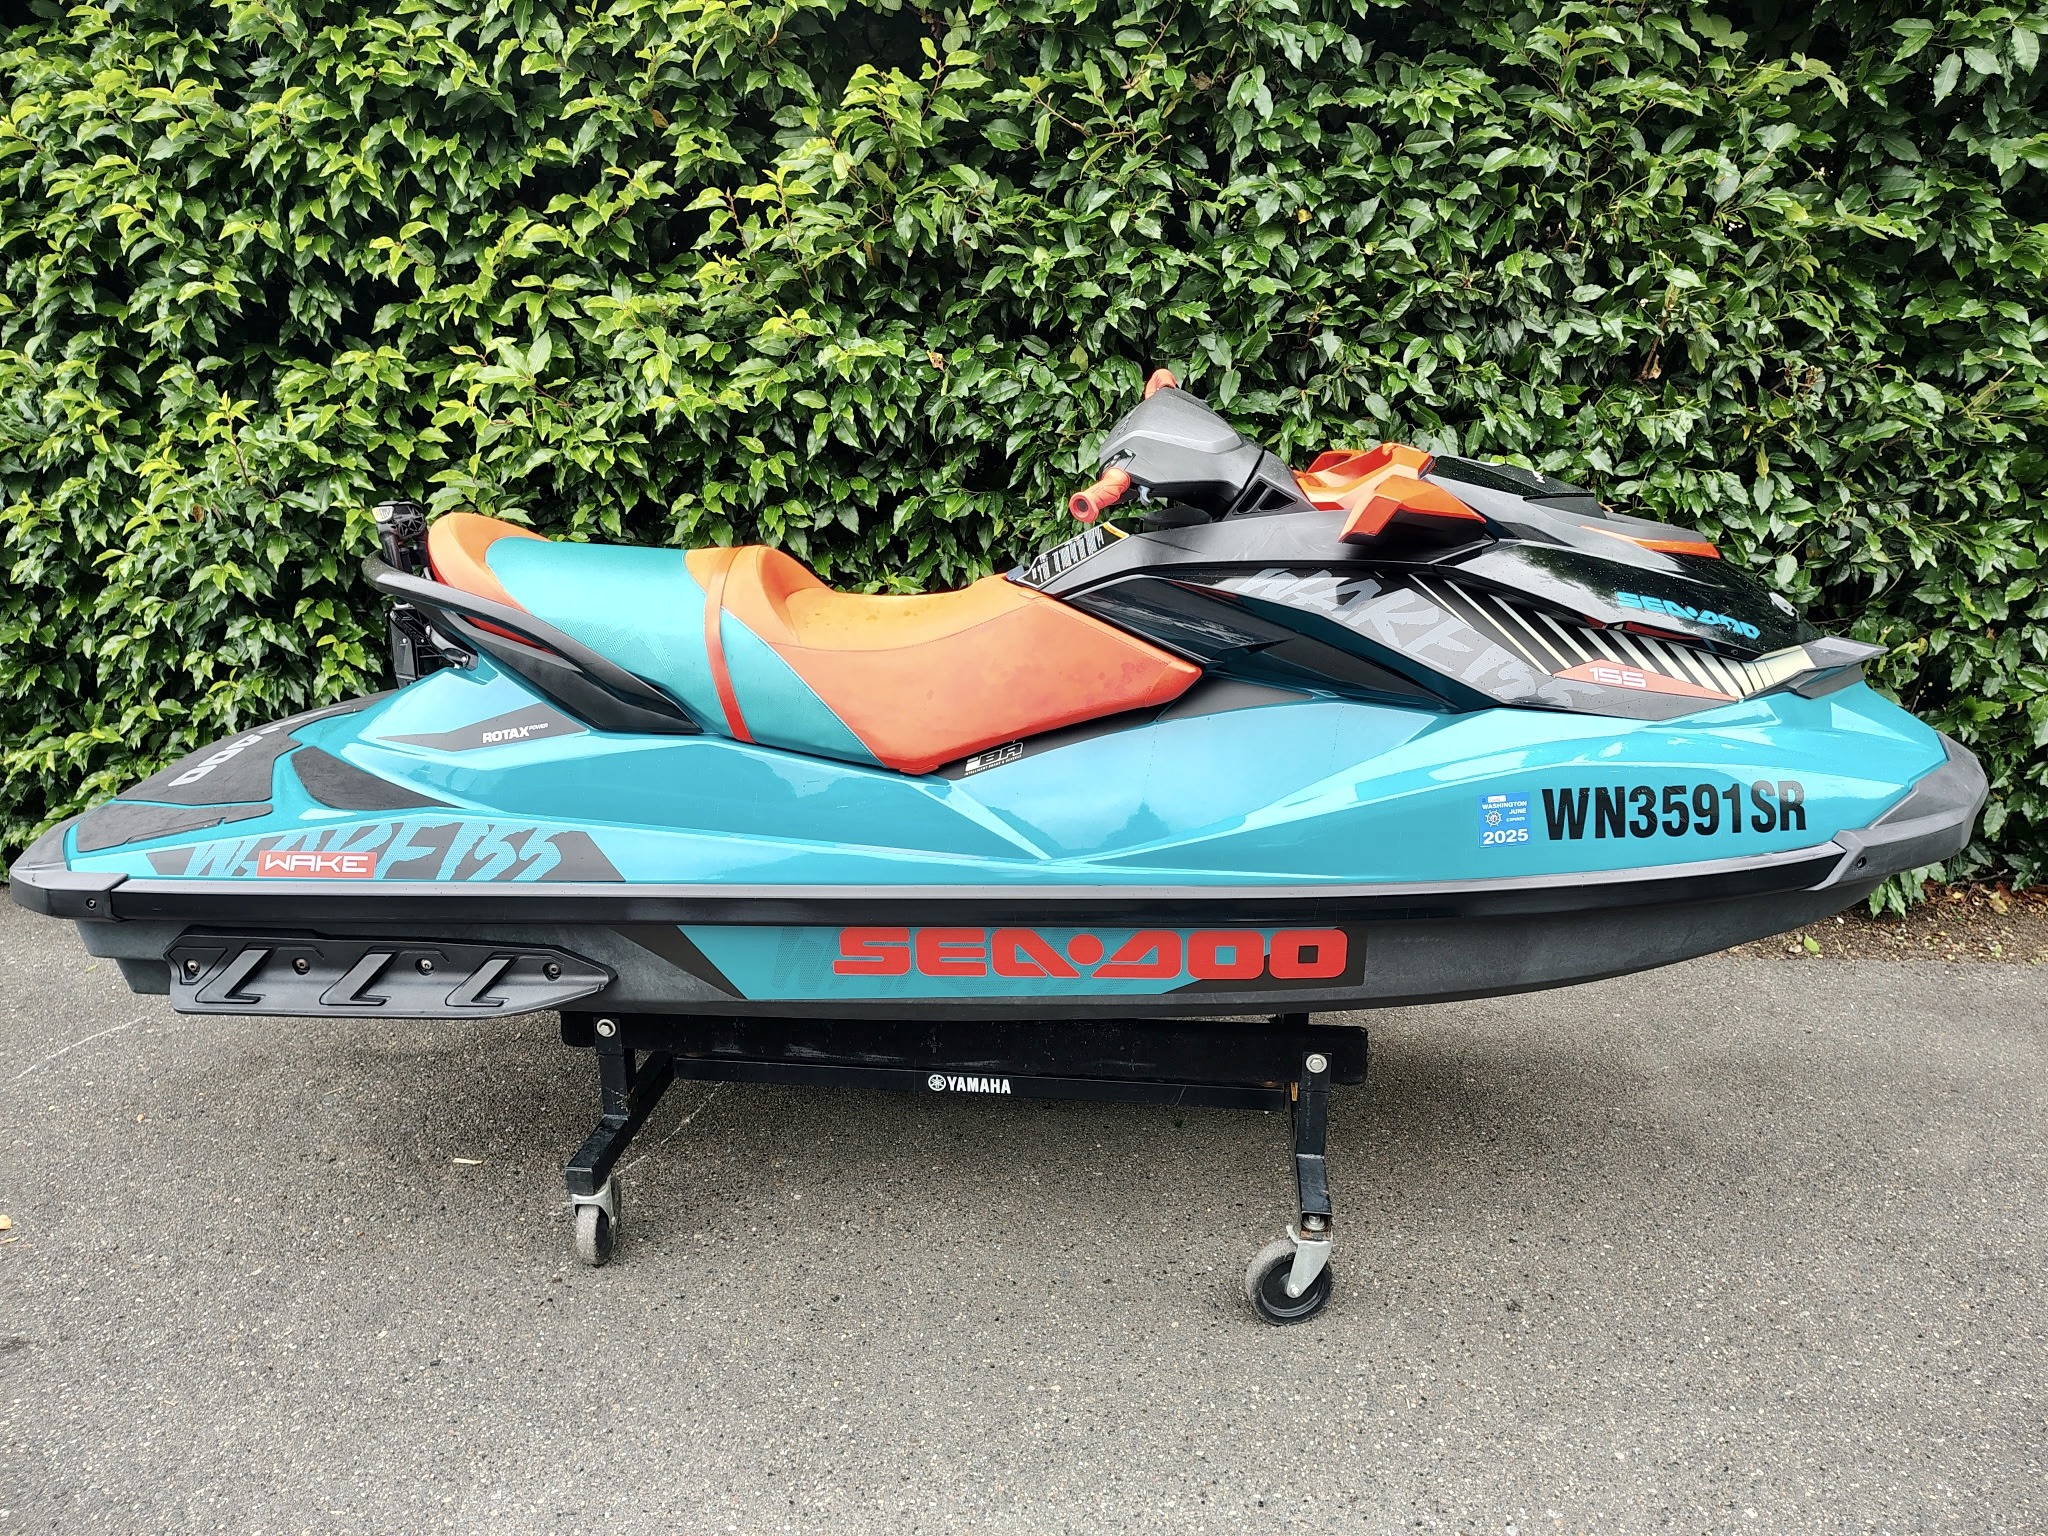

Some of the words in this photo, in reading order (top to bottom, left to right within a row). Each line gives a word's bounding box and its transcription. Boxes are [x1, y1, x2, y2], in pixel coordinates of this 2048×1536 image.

[1588, 666, 1648, 688] 155
[482, 725, 530, 743] ROTAX
[529, 722, 549, 731] POWER
[1482, 800, 1528, 810] WASHINGTON
[1509, 807, 1527, 815] JUNE
[1541, 780, 1807, 841] WN3591SR
[1483, 828, 1529, 845] 2025
[264, 854, 369, 873] WAKE
[946, 1076, 1011, 1094] YAMAHA
